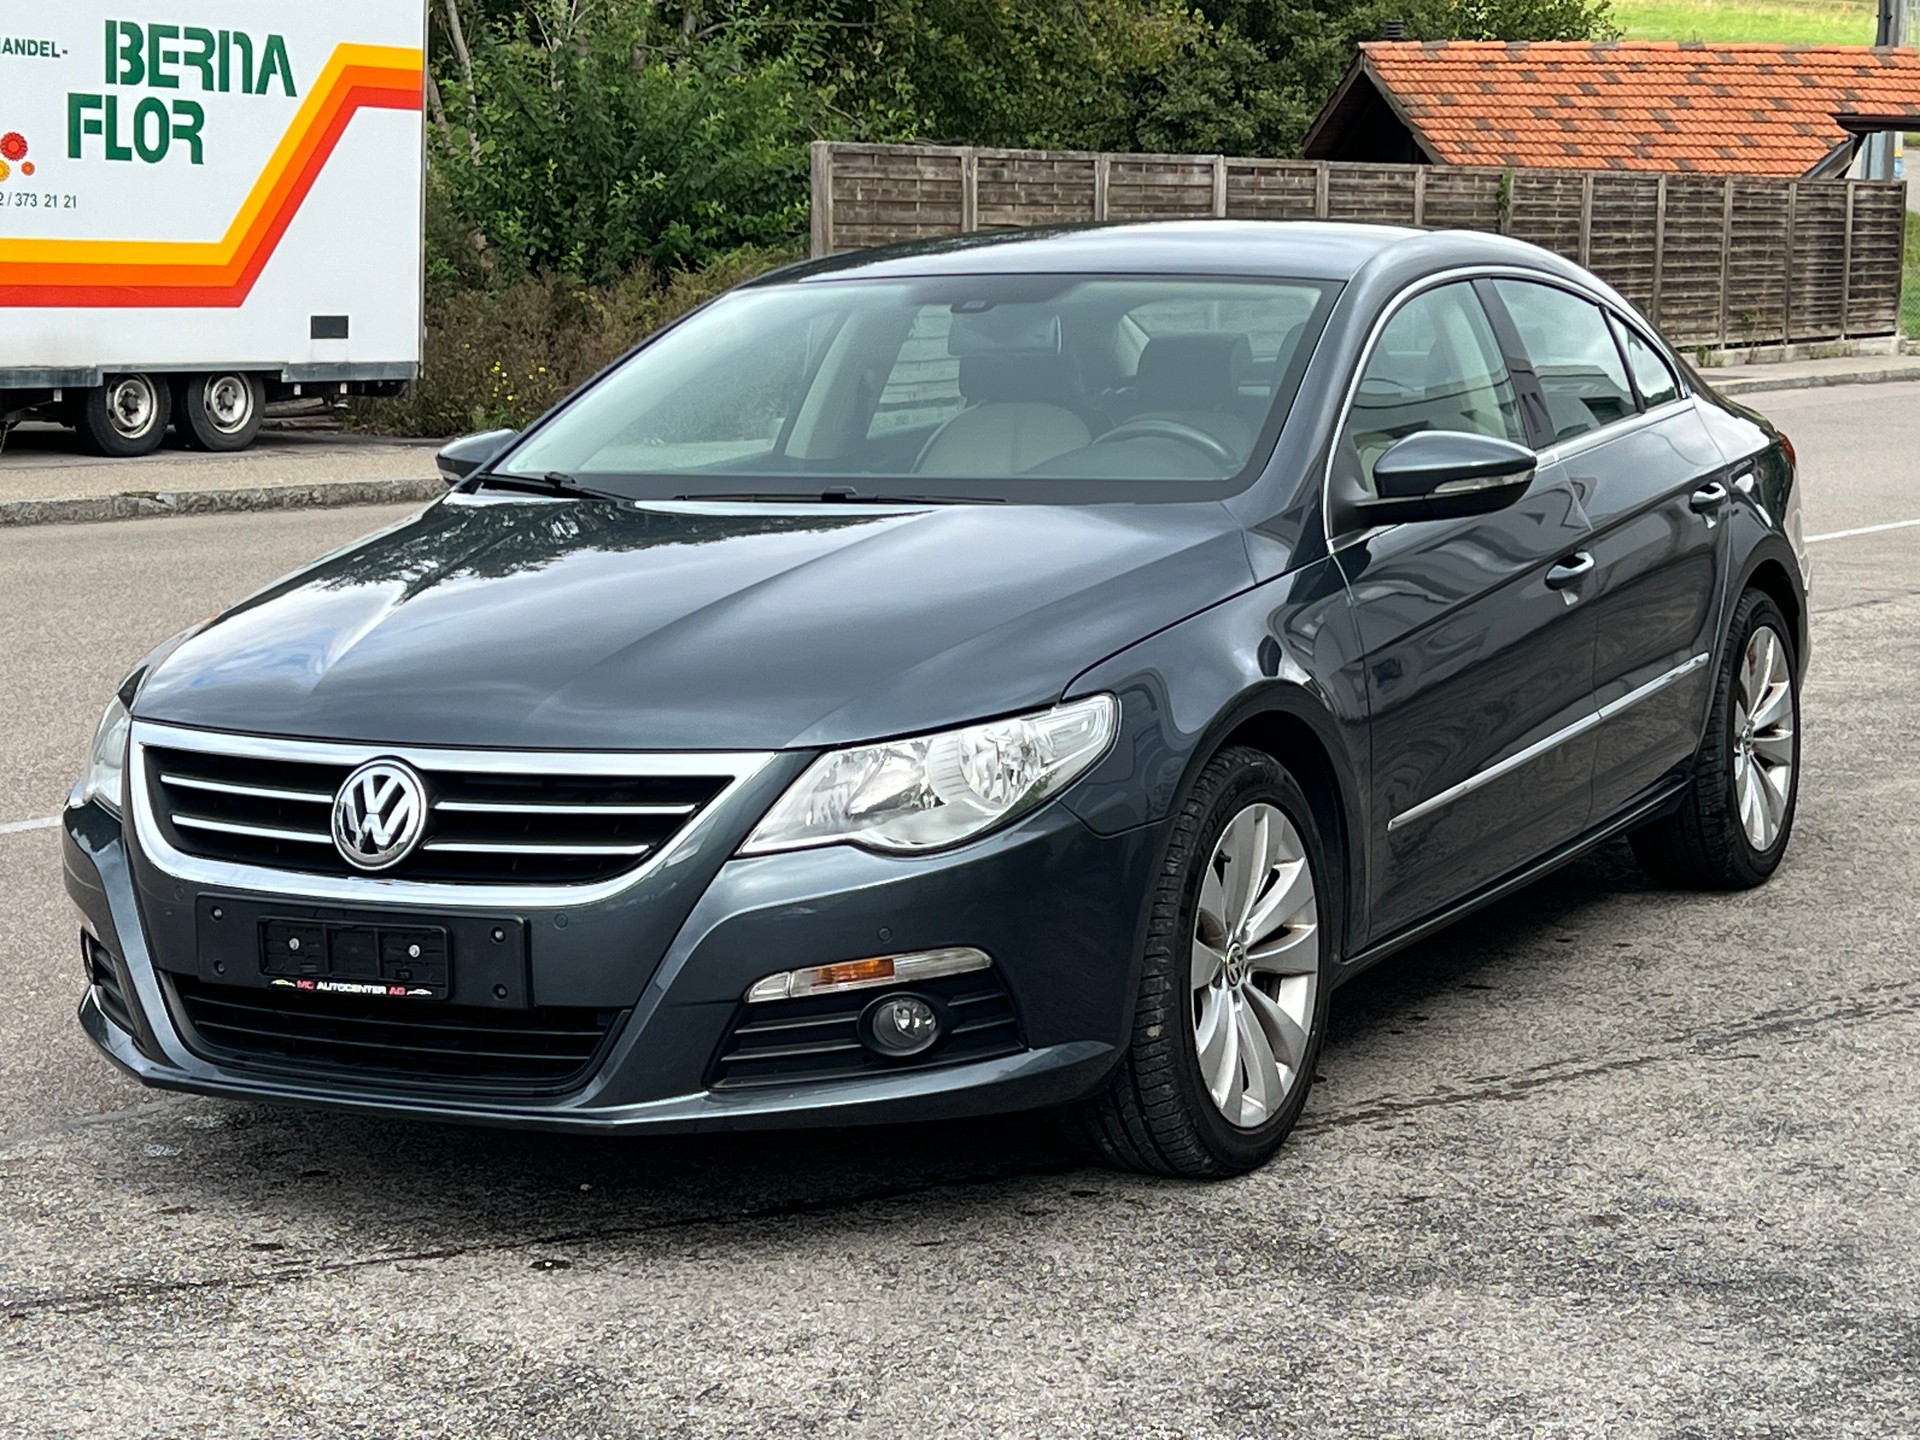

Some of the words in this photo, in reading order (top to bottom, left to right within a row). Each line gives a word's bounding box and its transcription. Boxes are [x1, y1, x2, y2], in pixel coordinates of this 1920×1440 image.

[0, 36, 69, 59] ANDEL-
[67, 92, 205, 165] FLOR
[44, 193, 58, 208] 21
[63, 194, 77, 209] 21
[332, 758, 427, 870] VW
[316, 981, 388, 996] AUTOCENTER
